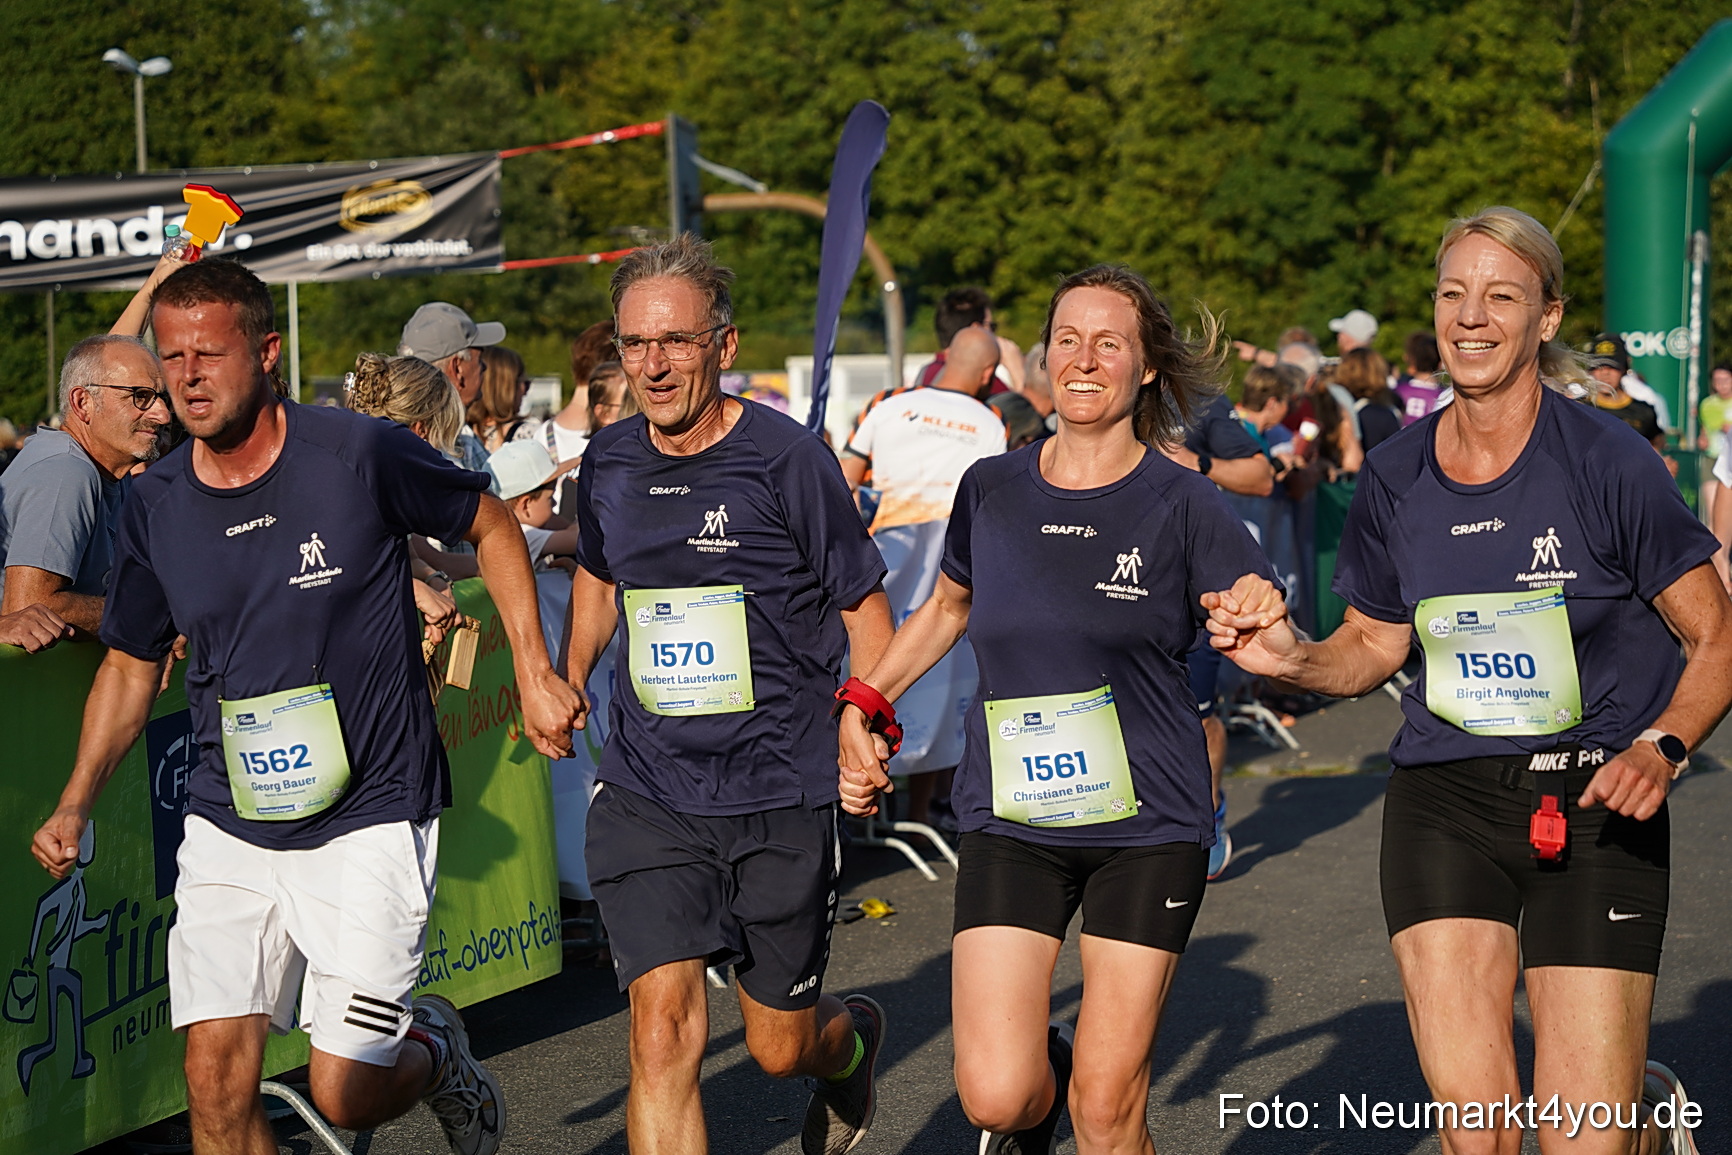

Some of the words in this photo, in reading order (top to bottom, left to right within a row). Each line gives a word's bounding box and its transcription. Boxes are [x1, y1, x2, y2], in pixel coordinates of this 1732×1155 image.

[1621, 331, 1667, 357] OK
[649, 486, 682, 495] CRAFT
[226, 518, 265, 536] CRAFT
[1041, 524, 1084, 535] CRAFT
[1451, 521, 1493, 536] CRAFT
[1528, 580, 1565, 589] FREYSTADT
[1106, 592, 1138, 601] FREYSTADT
[652, 613, 686, 622] Firmenlauf
[1452, 623, 1496, 632] Firmenlauf
[650, 641, 715, 667] 1570
[1456, 652, 1536, 679] 1560
[640, 674, 675, 684] Herbert
[678, 673, 738, 684] Lauterkorn
[1456, 688, 1492, 701] Birgit
[1495, 687, 1550, 700] Angloher
[234, 720, 272, 733] Firmenlauf
[1020, 722, 1056, 734] Firmenlauf
[239, 744, 312, 775] 1562
[1022, 750, 1088, 782] 1561
[1528, 752, 1570, 771] NIKE
[1578, 748, 1605, 767] PR
[174, 764, 194, 799] Fi
[251, 781, 280, 792] Georg
[282, 776, 317, 790] Bauer
[1014, 787, 1073, 802] Christiane
[1075, 781, 1111, 794] Bauer
